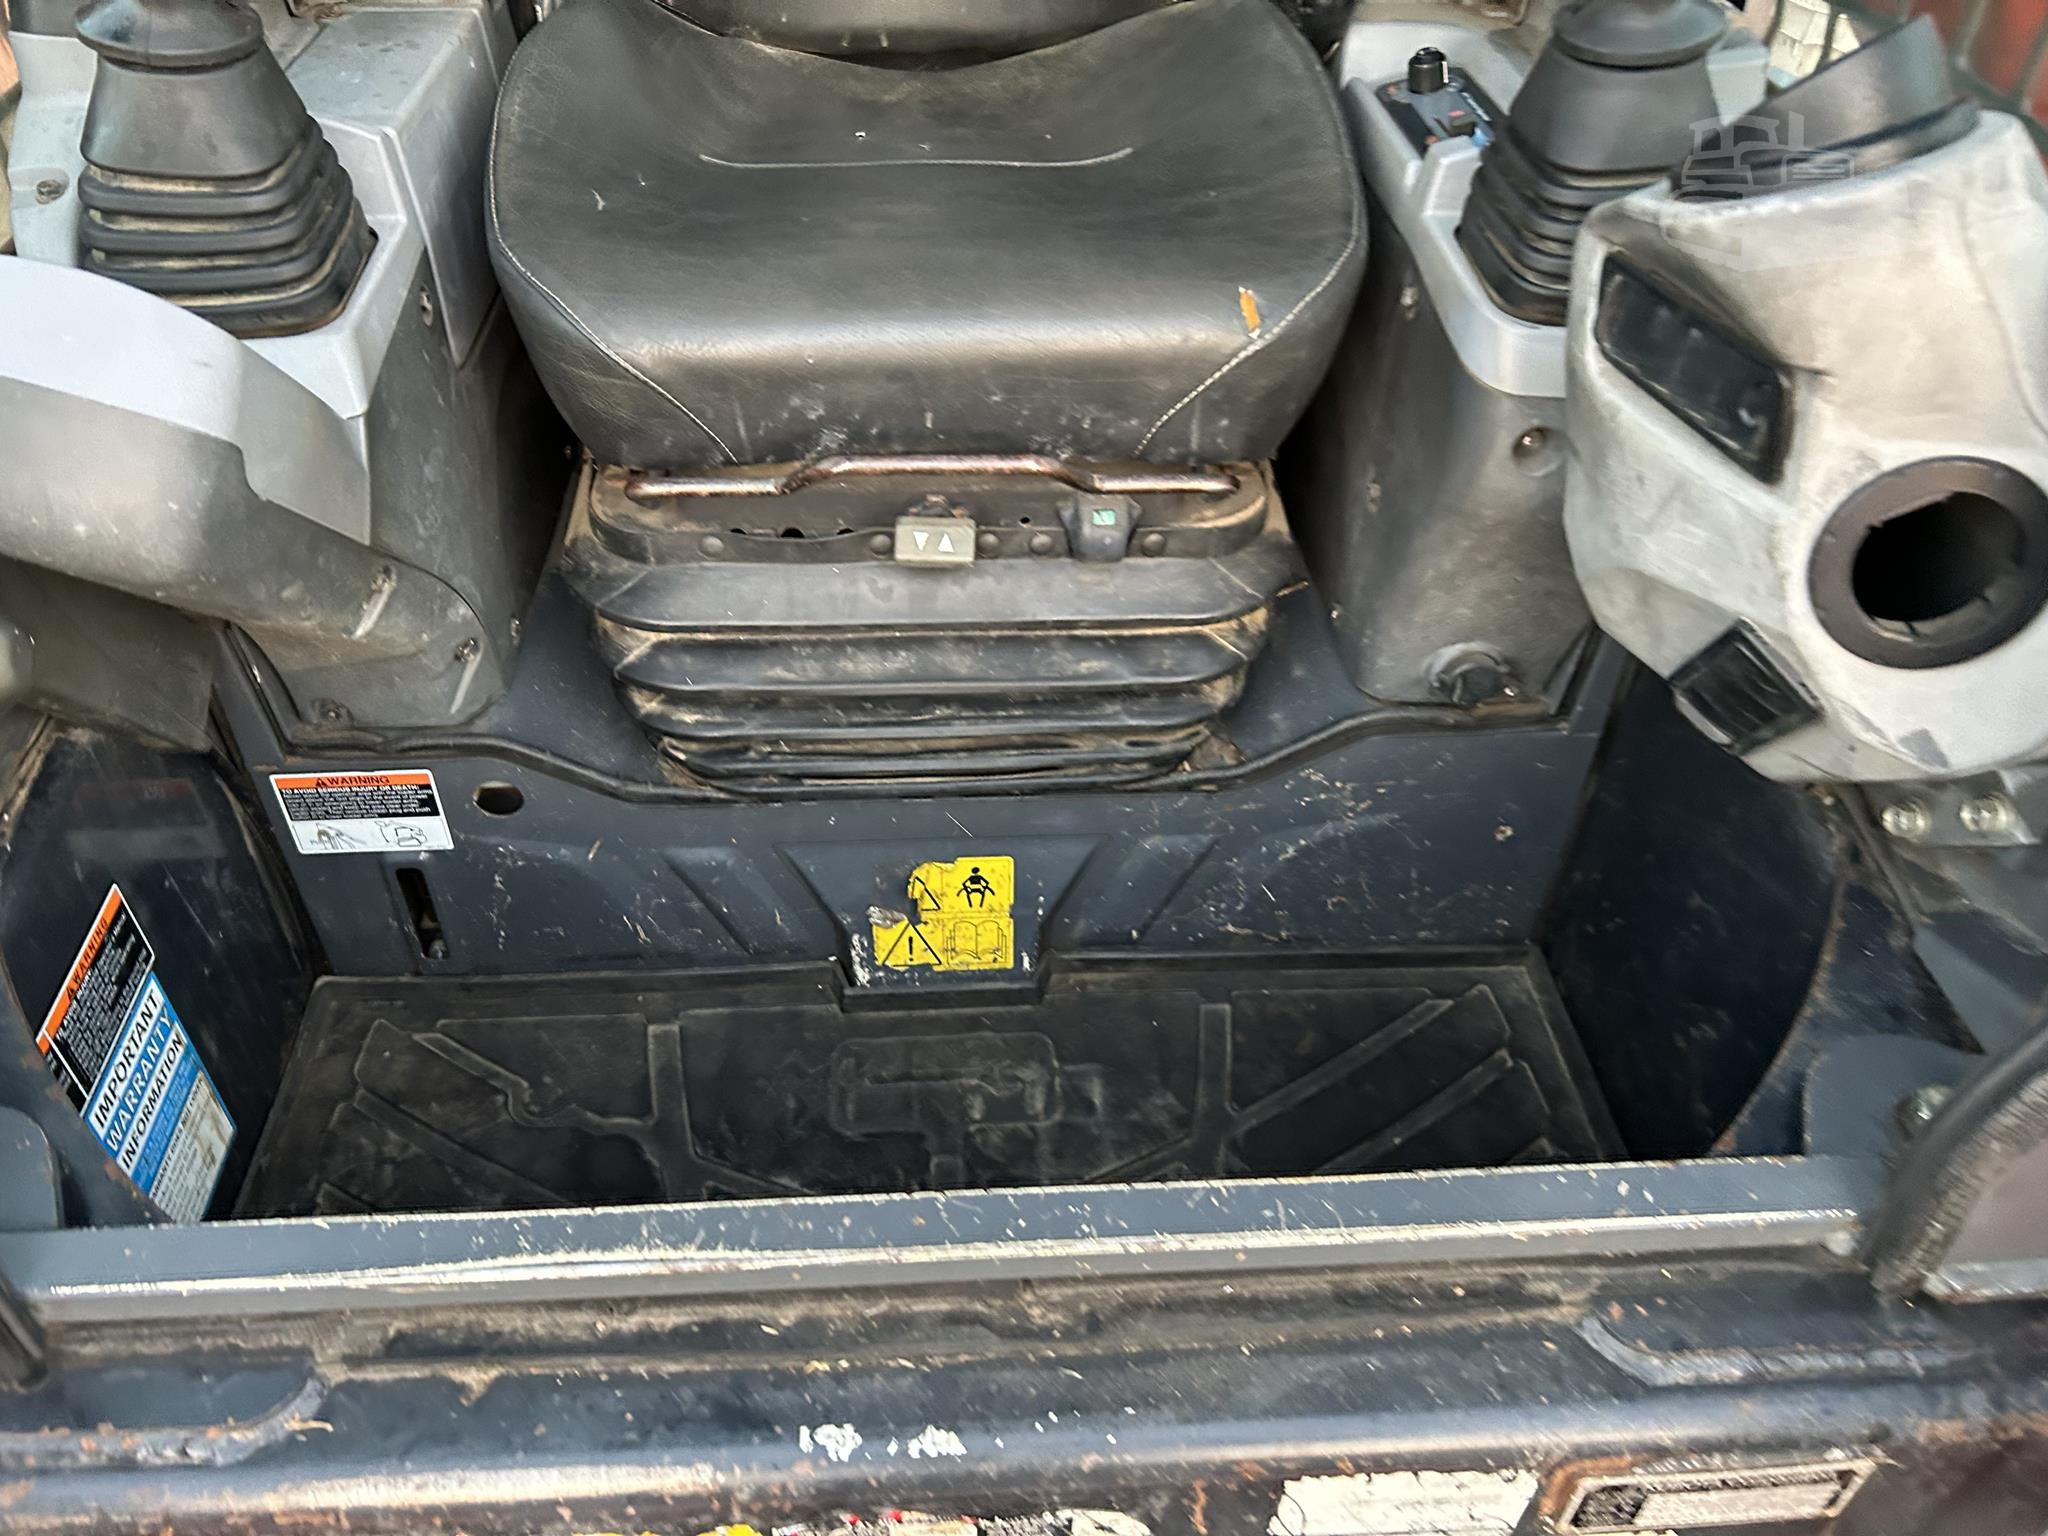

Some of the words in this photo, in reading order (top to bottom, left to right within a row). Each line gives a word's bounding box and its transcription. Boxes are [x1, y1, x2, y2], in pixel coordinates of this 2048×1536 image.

[328, 776, 390, 786] WARNING
[71, 916, 108, 985] WARNING
[94, 987, 159, 1129] IMPORTANT
[105, 1006, 171, 1152] WARRANTY
[121, 1030, 182, 1169] INFORMATION
